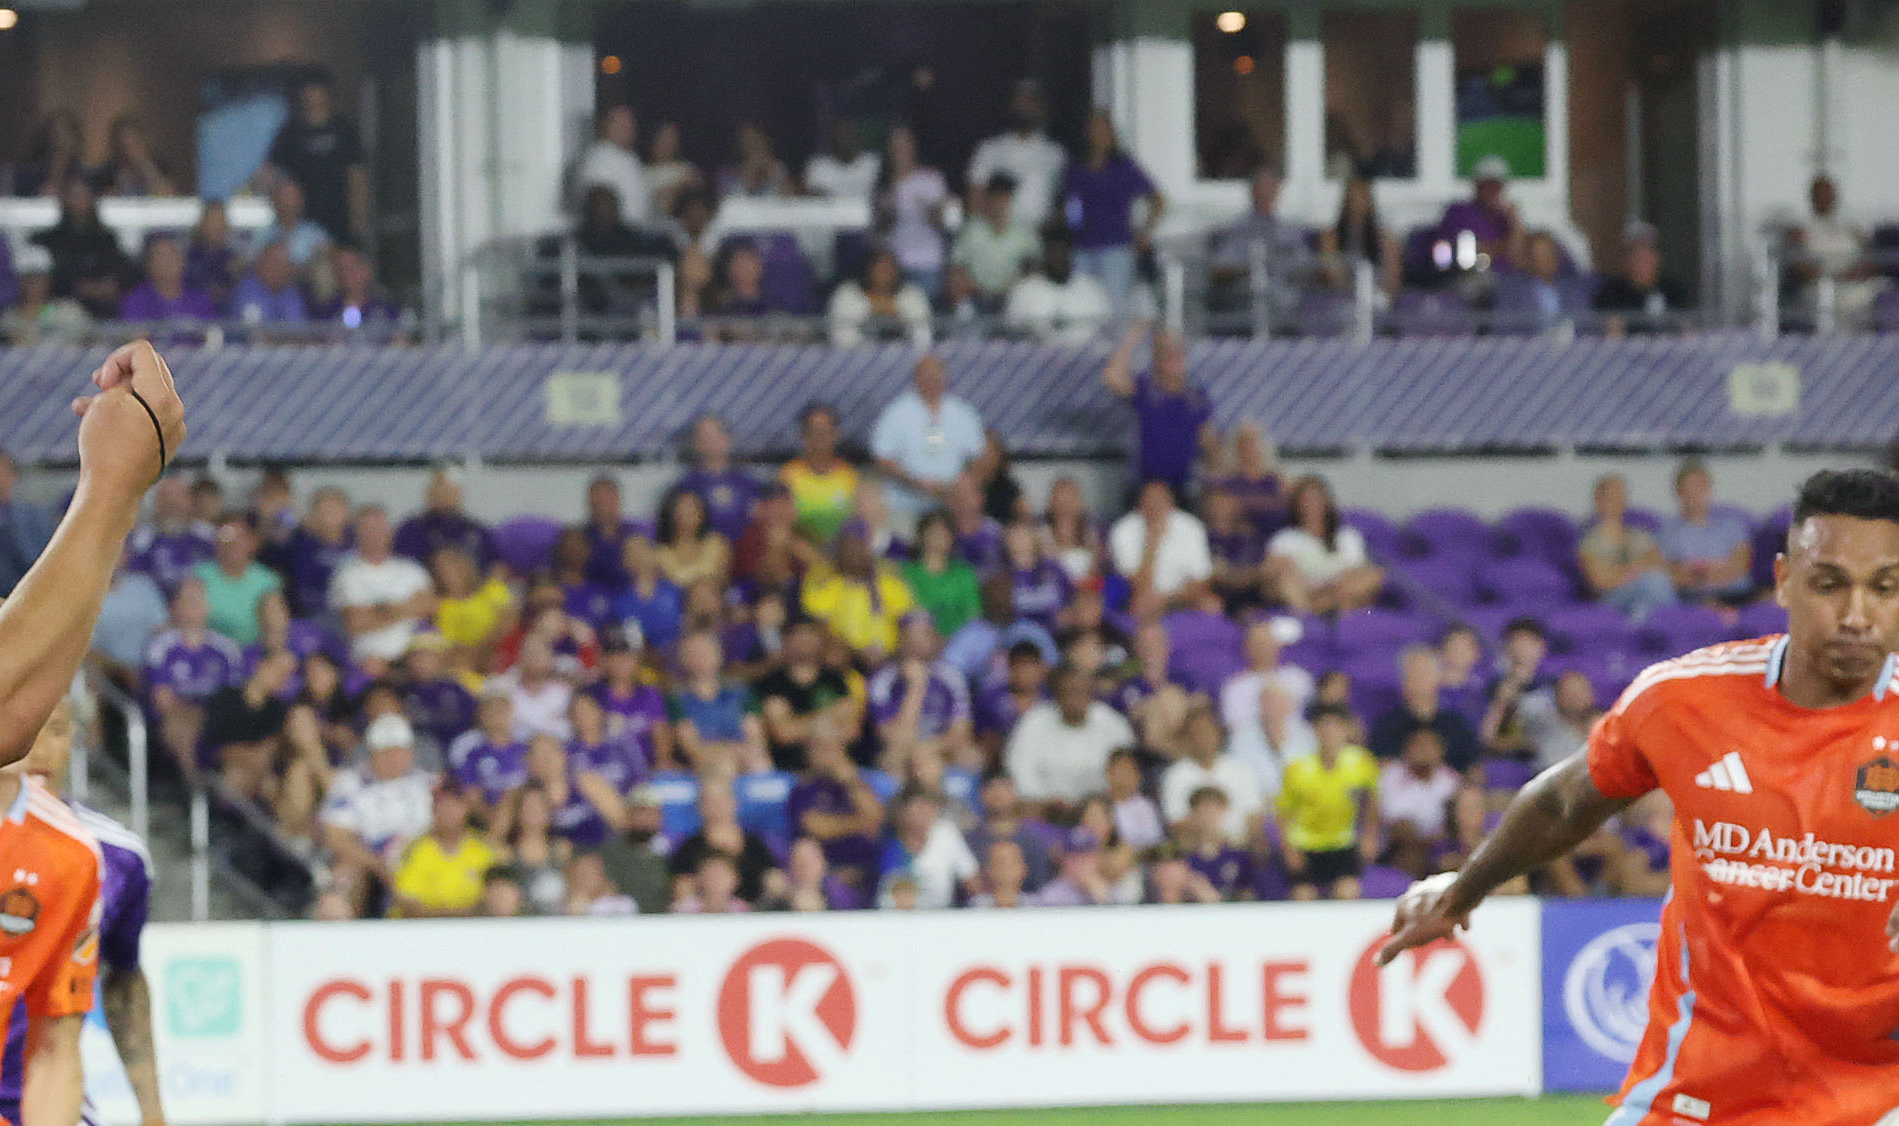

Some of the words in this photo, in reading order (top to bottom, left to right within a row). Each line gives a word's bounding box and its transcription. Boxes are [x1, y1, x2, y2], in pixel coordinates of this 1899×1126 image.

[1694, 819, 1750, 854] MD
[1750, 827, 1896, 873] Anderson
[1696, 848, 1796, 892] Cancer
[1795, 863, 1896, 902] Center
[303, 976, 677, 1062] CIRCLE
[742, 957, 852, 1079] K
[944, 962, 1309, 1048] CIRCLE
[1372, 943, 1480, 1065] K
